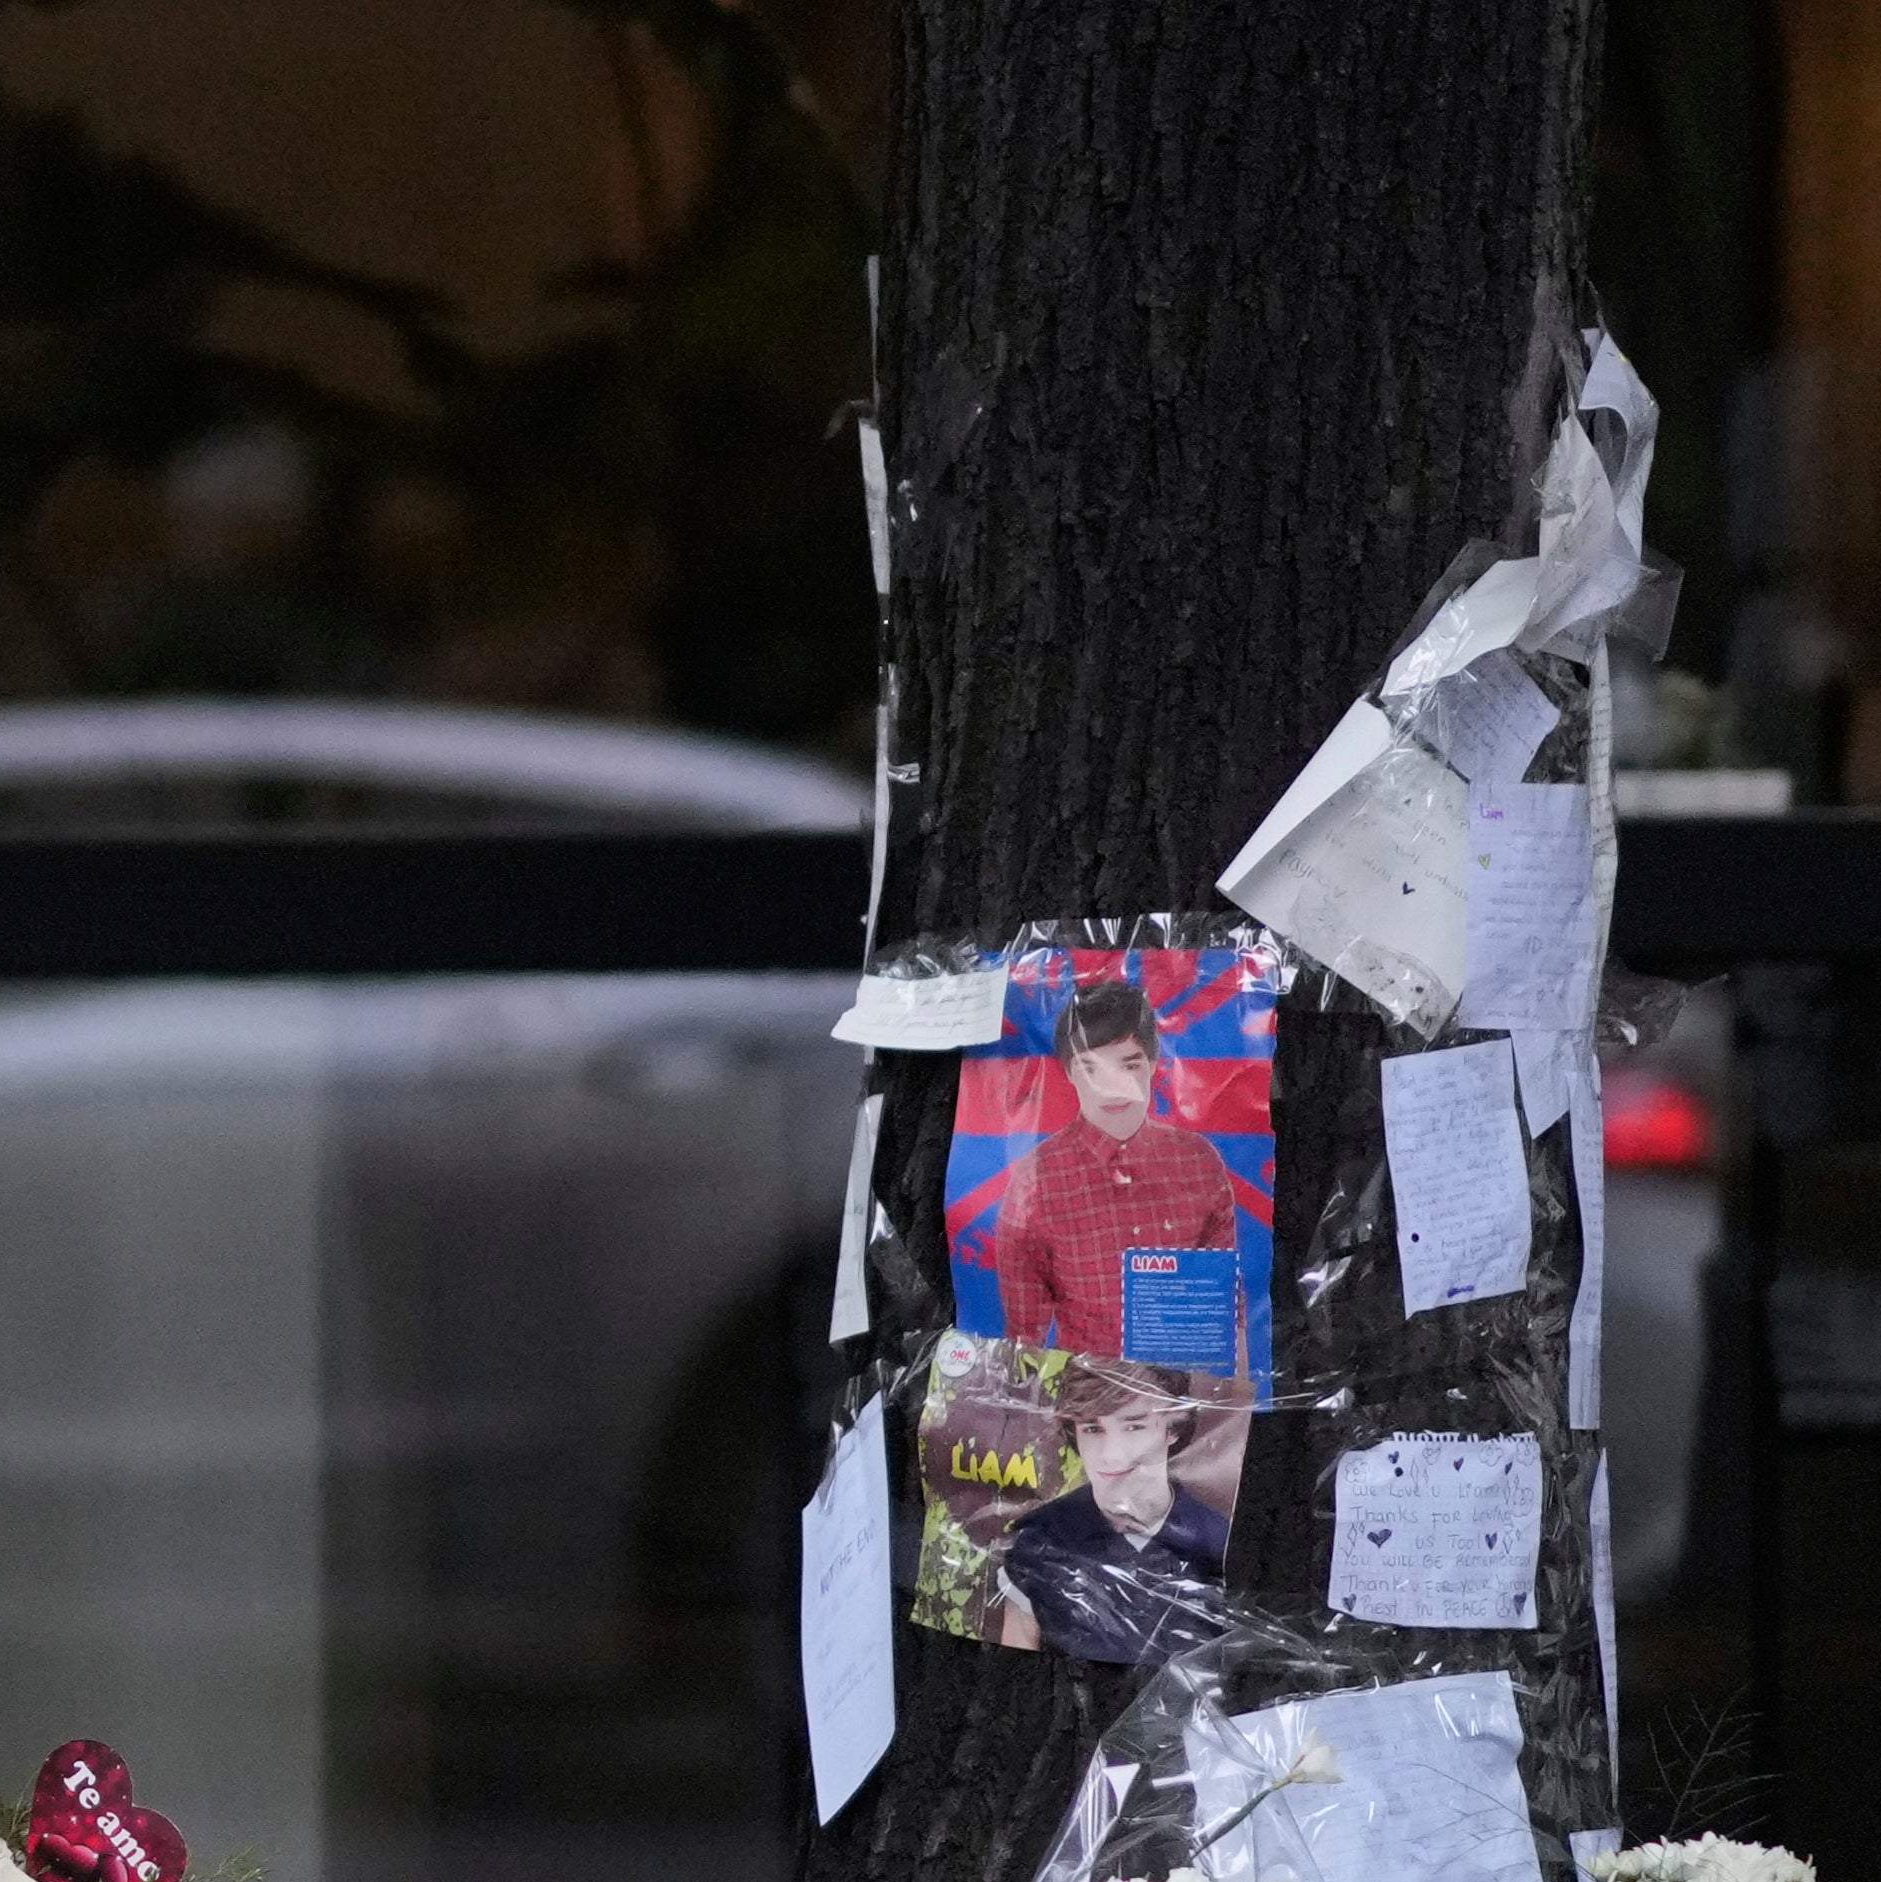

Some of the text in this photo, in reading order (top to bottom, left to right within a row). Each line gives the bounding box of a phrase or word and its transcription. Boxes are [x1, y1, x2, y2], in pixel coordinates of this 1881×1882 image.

[1132, 1254, 1178, 1274] LIAM
[63, 1760, 160, 1882] Te amo
